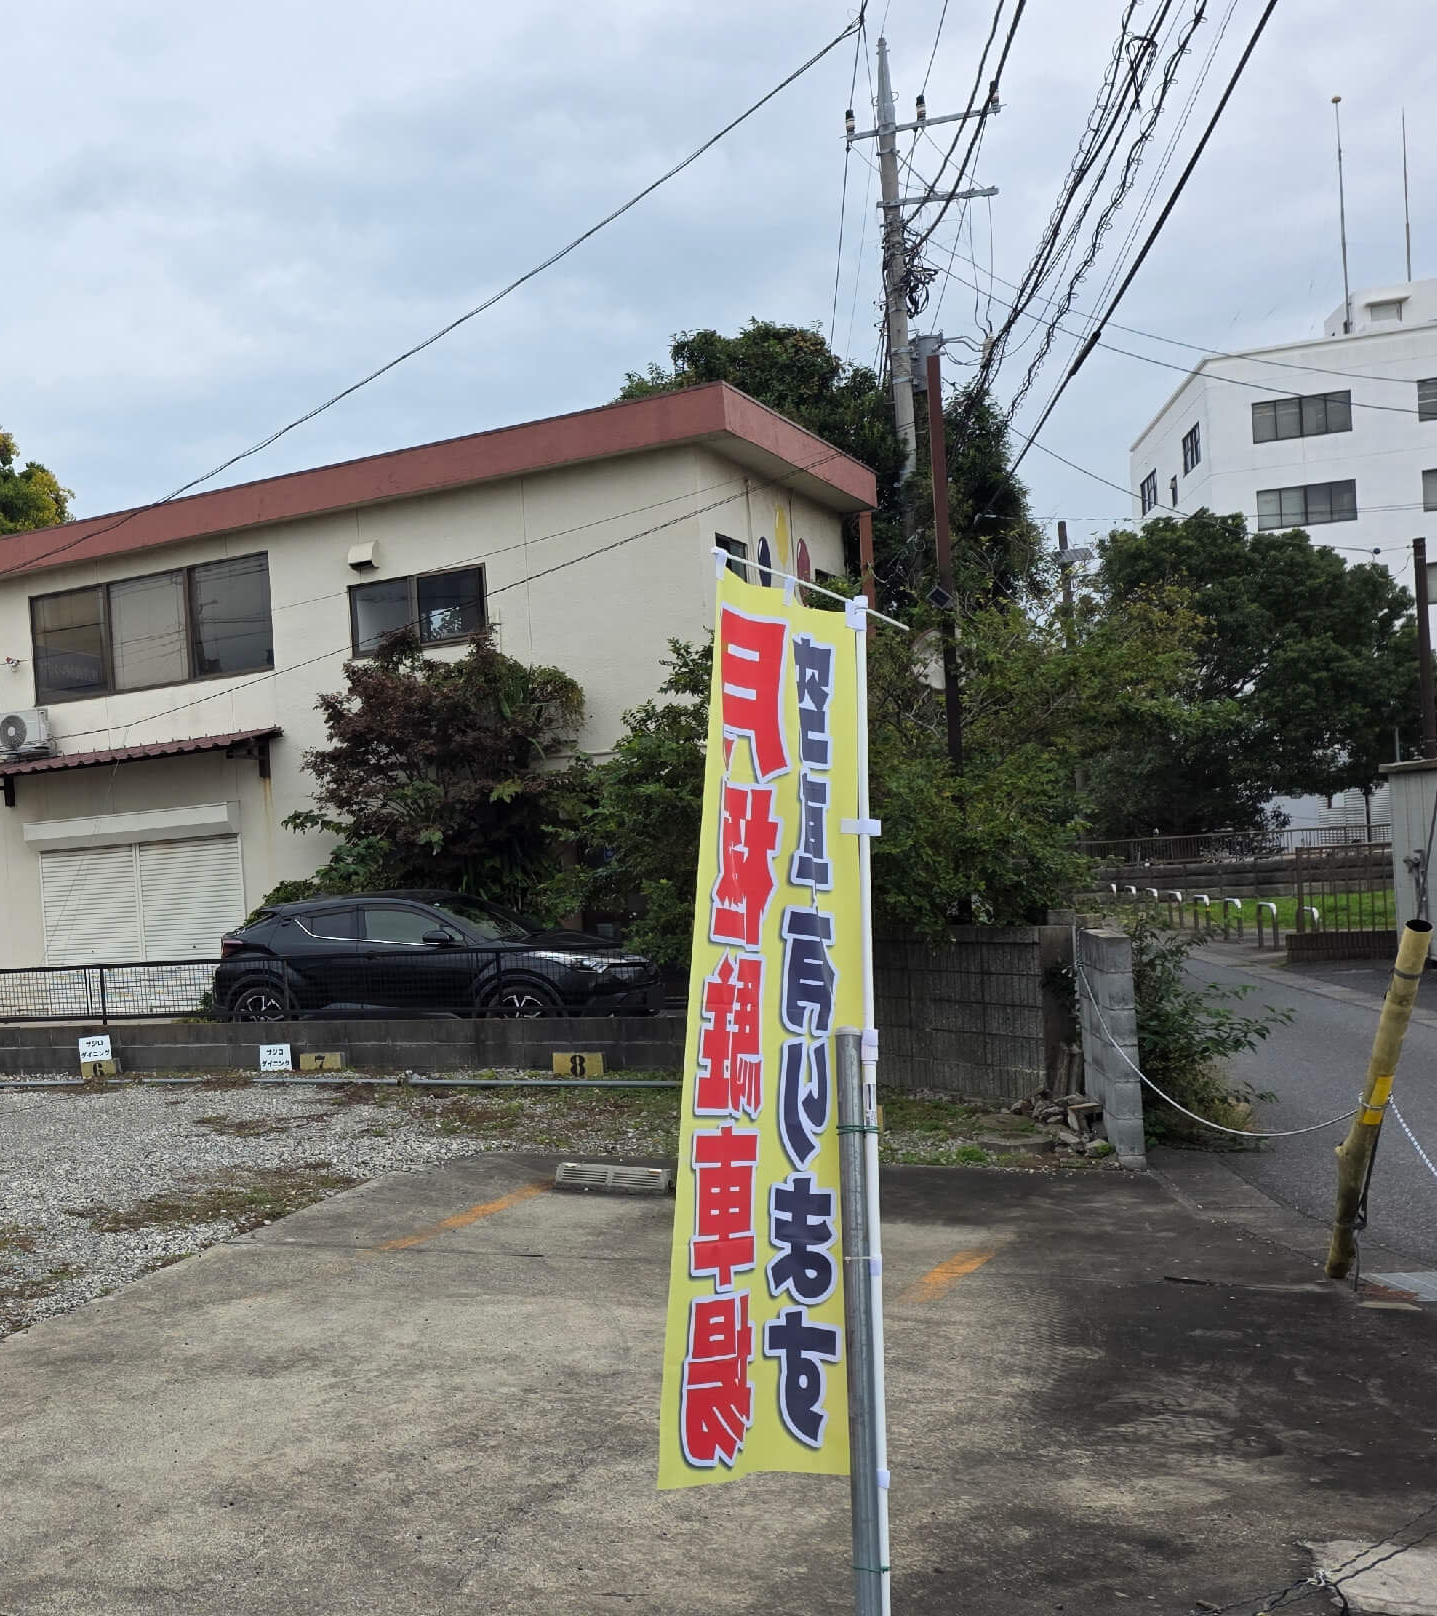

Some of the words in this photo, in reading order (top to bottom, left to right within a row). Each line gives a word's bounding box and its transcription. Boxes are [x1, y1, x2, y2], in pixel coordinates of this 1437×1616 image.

[315, 1055, 325, 1069] 7
[570, 1055, 586, 1077] 8
[93, 1063, 104, 1077] 6
